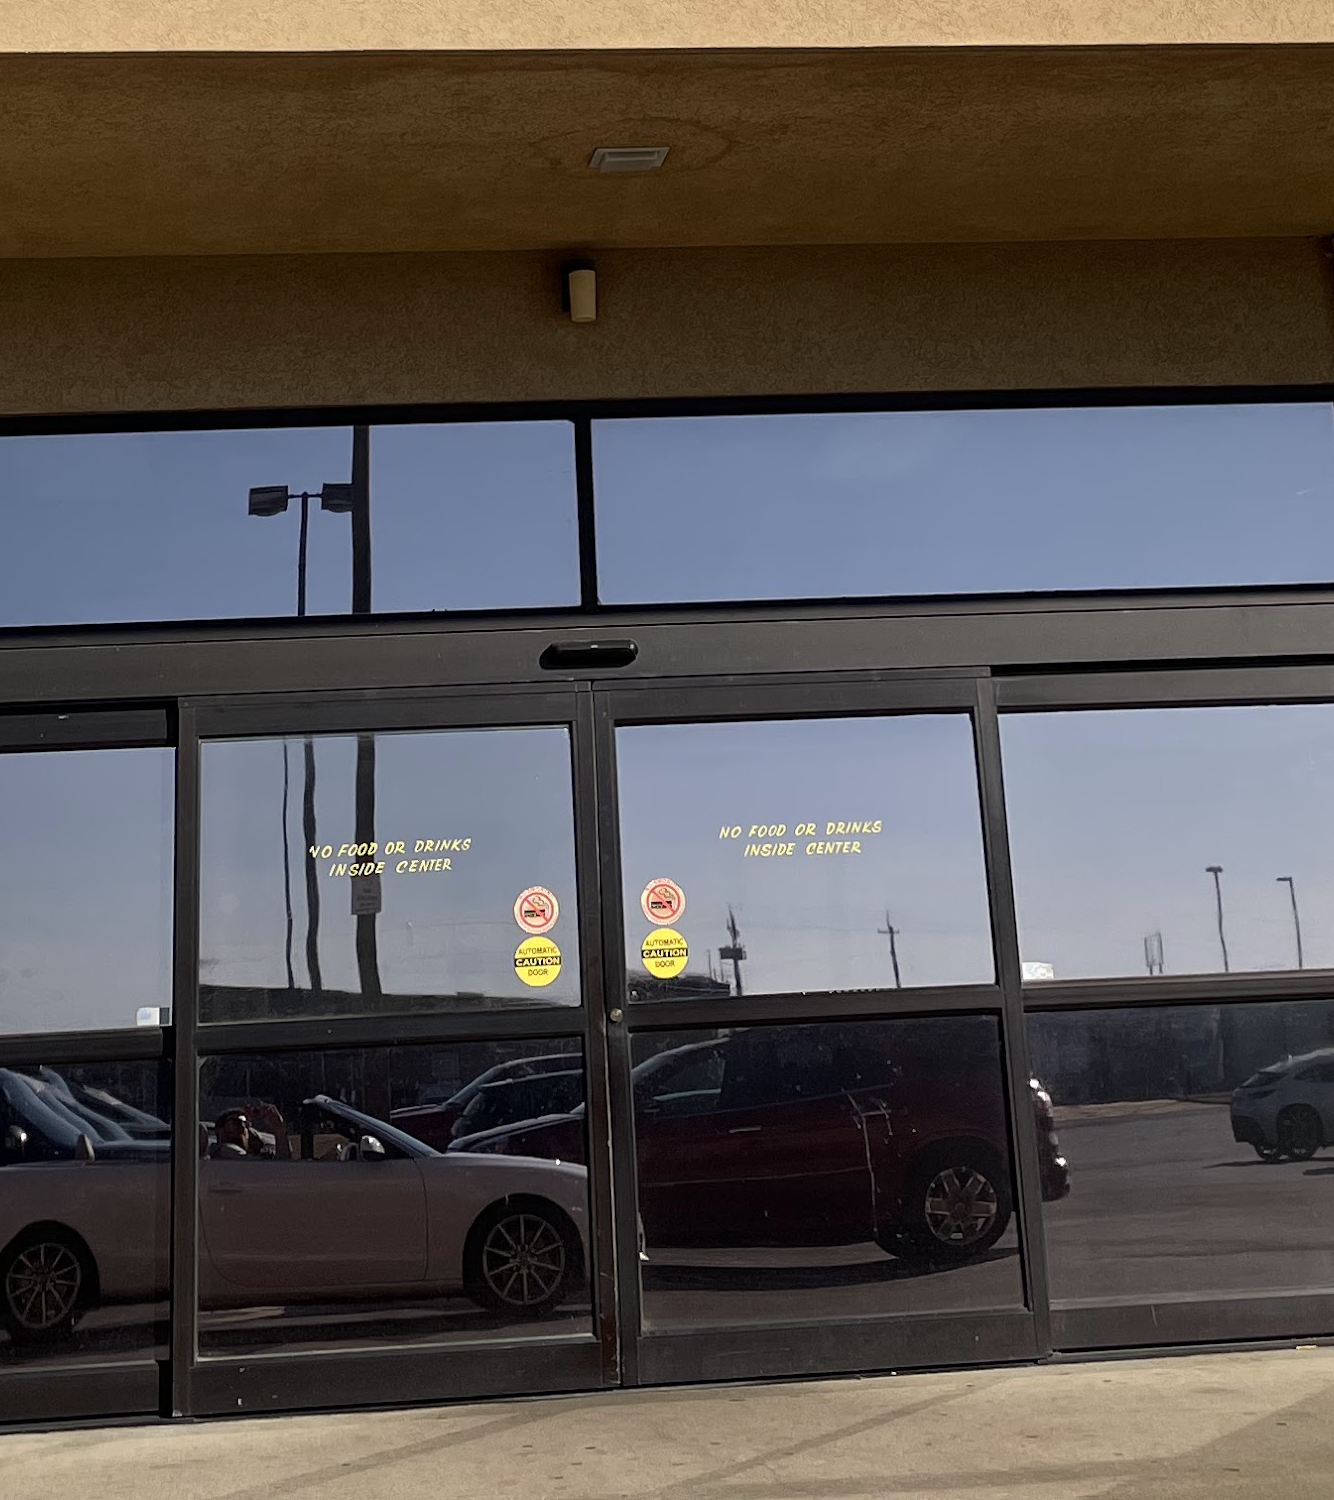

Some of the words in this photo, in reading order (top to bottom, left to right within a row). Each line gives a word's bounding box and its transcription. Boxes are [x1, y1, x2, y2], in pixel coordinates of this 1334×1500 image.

[719, 825, 742, 840] NO
[748, 823, 787, 838] FOOD
[794, 822, 817, 836] OR
[826, 820, 883, 835] DRINKS
[309, 844, 333, 859] NO
[337, 841, 379, 857] FOOD
[384, 840, 406, 855] OR
[414, 838, 472, 853] DRINKS
[744, 842, 796, 857] INSIDE
[805, 841, 862, 855] CENTER
[329, 861, 386, 877] INSIDE
[395, 858, 452, 874] CENTER
[646, 938, 684, 947] AUTOMATIC
[518, 946, 557, 956] AUTOMATIC
[642, 948, 687, 958] CAUTION
[515, 956, 560, 966] CAUTION
[655, 960, 675, 968] DOOR
[527, 968, 548, 976] DOOR
